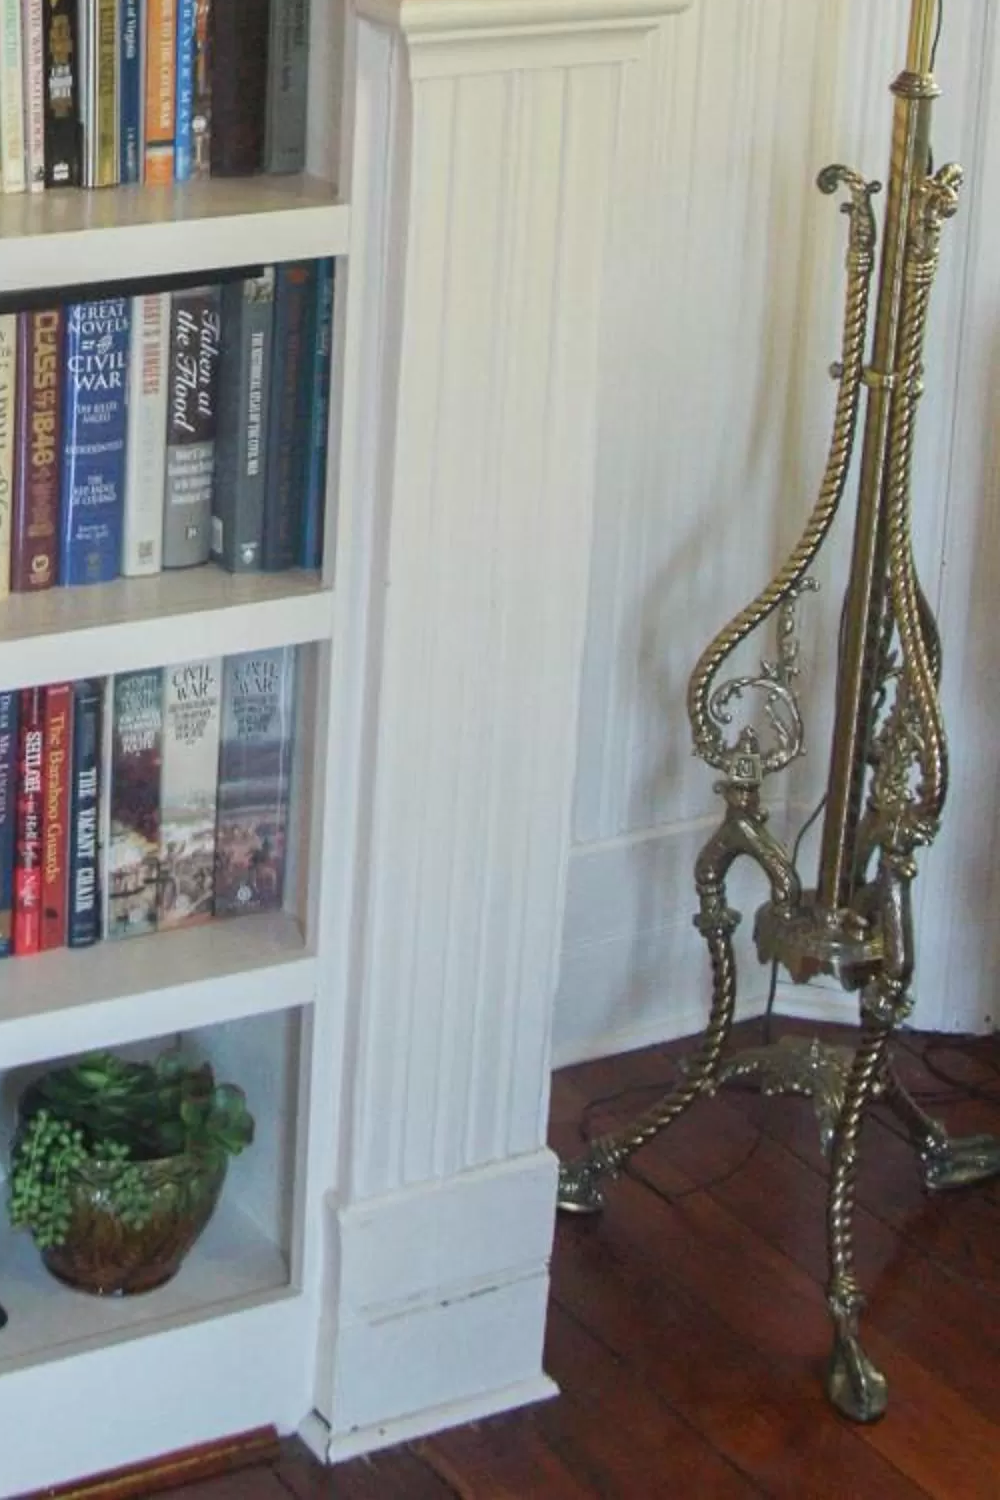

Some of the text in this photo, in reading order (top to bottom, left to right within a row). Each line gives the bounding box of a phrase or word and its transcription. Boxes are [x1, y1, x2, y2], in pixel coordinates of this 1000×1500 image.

[123, 18, 138, 59] Virginia
[180, 88, 192, 136] MAN
[67, 316, 130, 335] NOVELS
[76, 303, 125, 322] GREAT
[174, 308, 199, 347] the
[32, 311, 59, 388] CLASS
[66, 351, 126, 374] CIVIL
[196, 308, 222, 417] Taken at
[73, 371, 122, 392] WAR
[172, 351, 198, 433] Flood
[171, 663, 216, 688] CIVIL
[233, 660, 280, 682] CIVIL
[239, 677, 274, 695] WAR
[176, 680, 209, 701] WAR
[23, 730, 43, 794] SHILOH
[45, 711, 66, 885] The Baraboo Guards
[25, 814, 39, 838] Hell
[74, 767, 98, 913] THE VACANT CHAIR
[22, 873, 38, 908] Night
